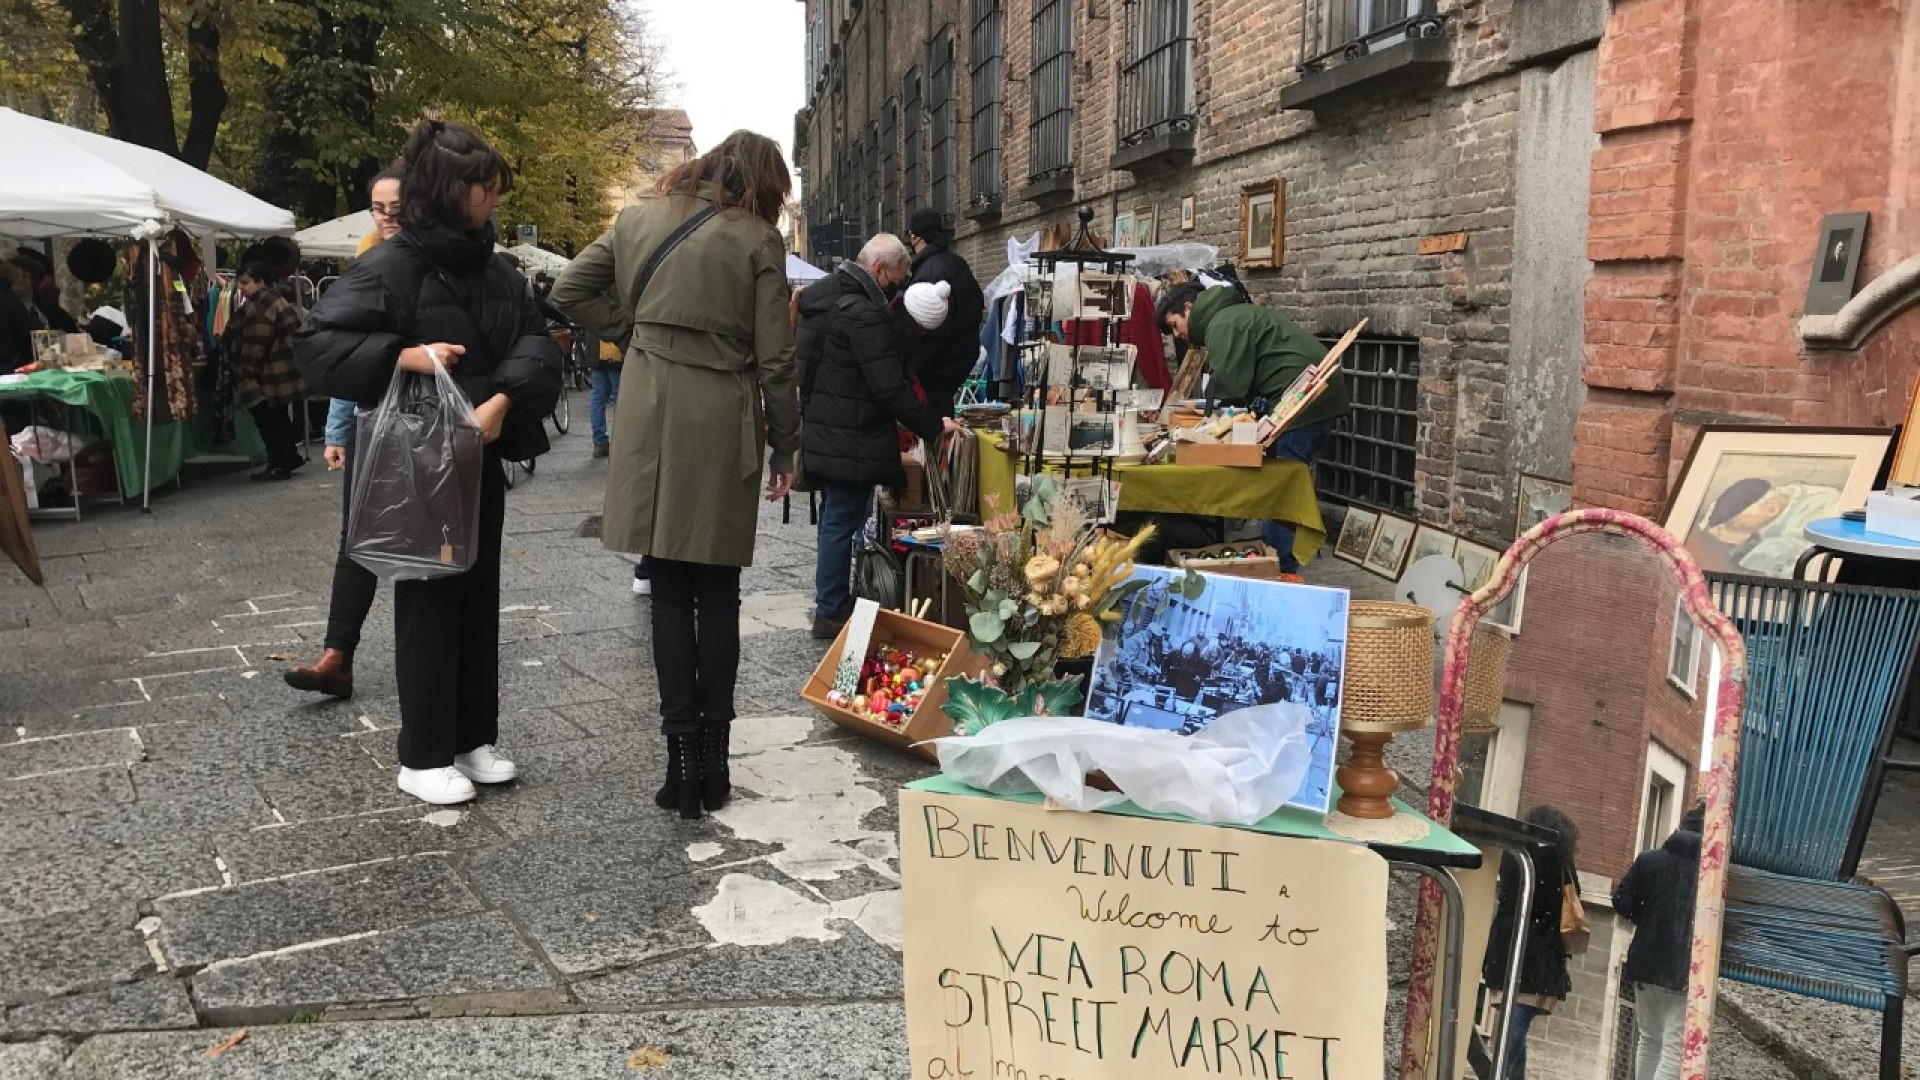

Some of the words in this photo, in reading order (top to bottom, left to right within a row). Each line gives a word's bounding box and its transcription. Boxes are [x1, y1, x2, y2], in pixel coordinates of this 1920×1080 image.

[923, 805, 1246, 895] BENVENUTI
[1066, 885, 1232, 935] Welcome
[1258, 914, 1320, 947] to
[991, 926, 1093, 990] VIA
[1121, 945, 1280, 1015] ROMA
[938, 968, 1118, 1060] STREET
[1131, 1006, 1341, 1080] MARKET
